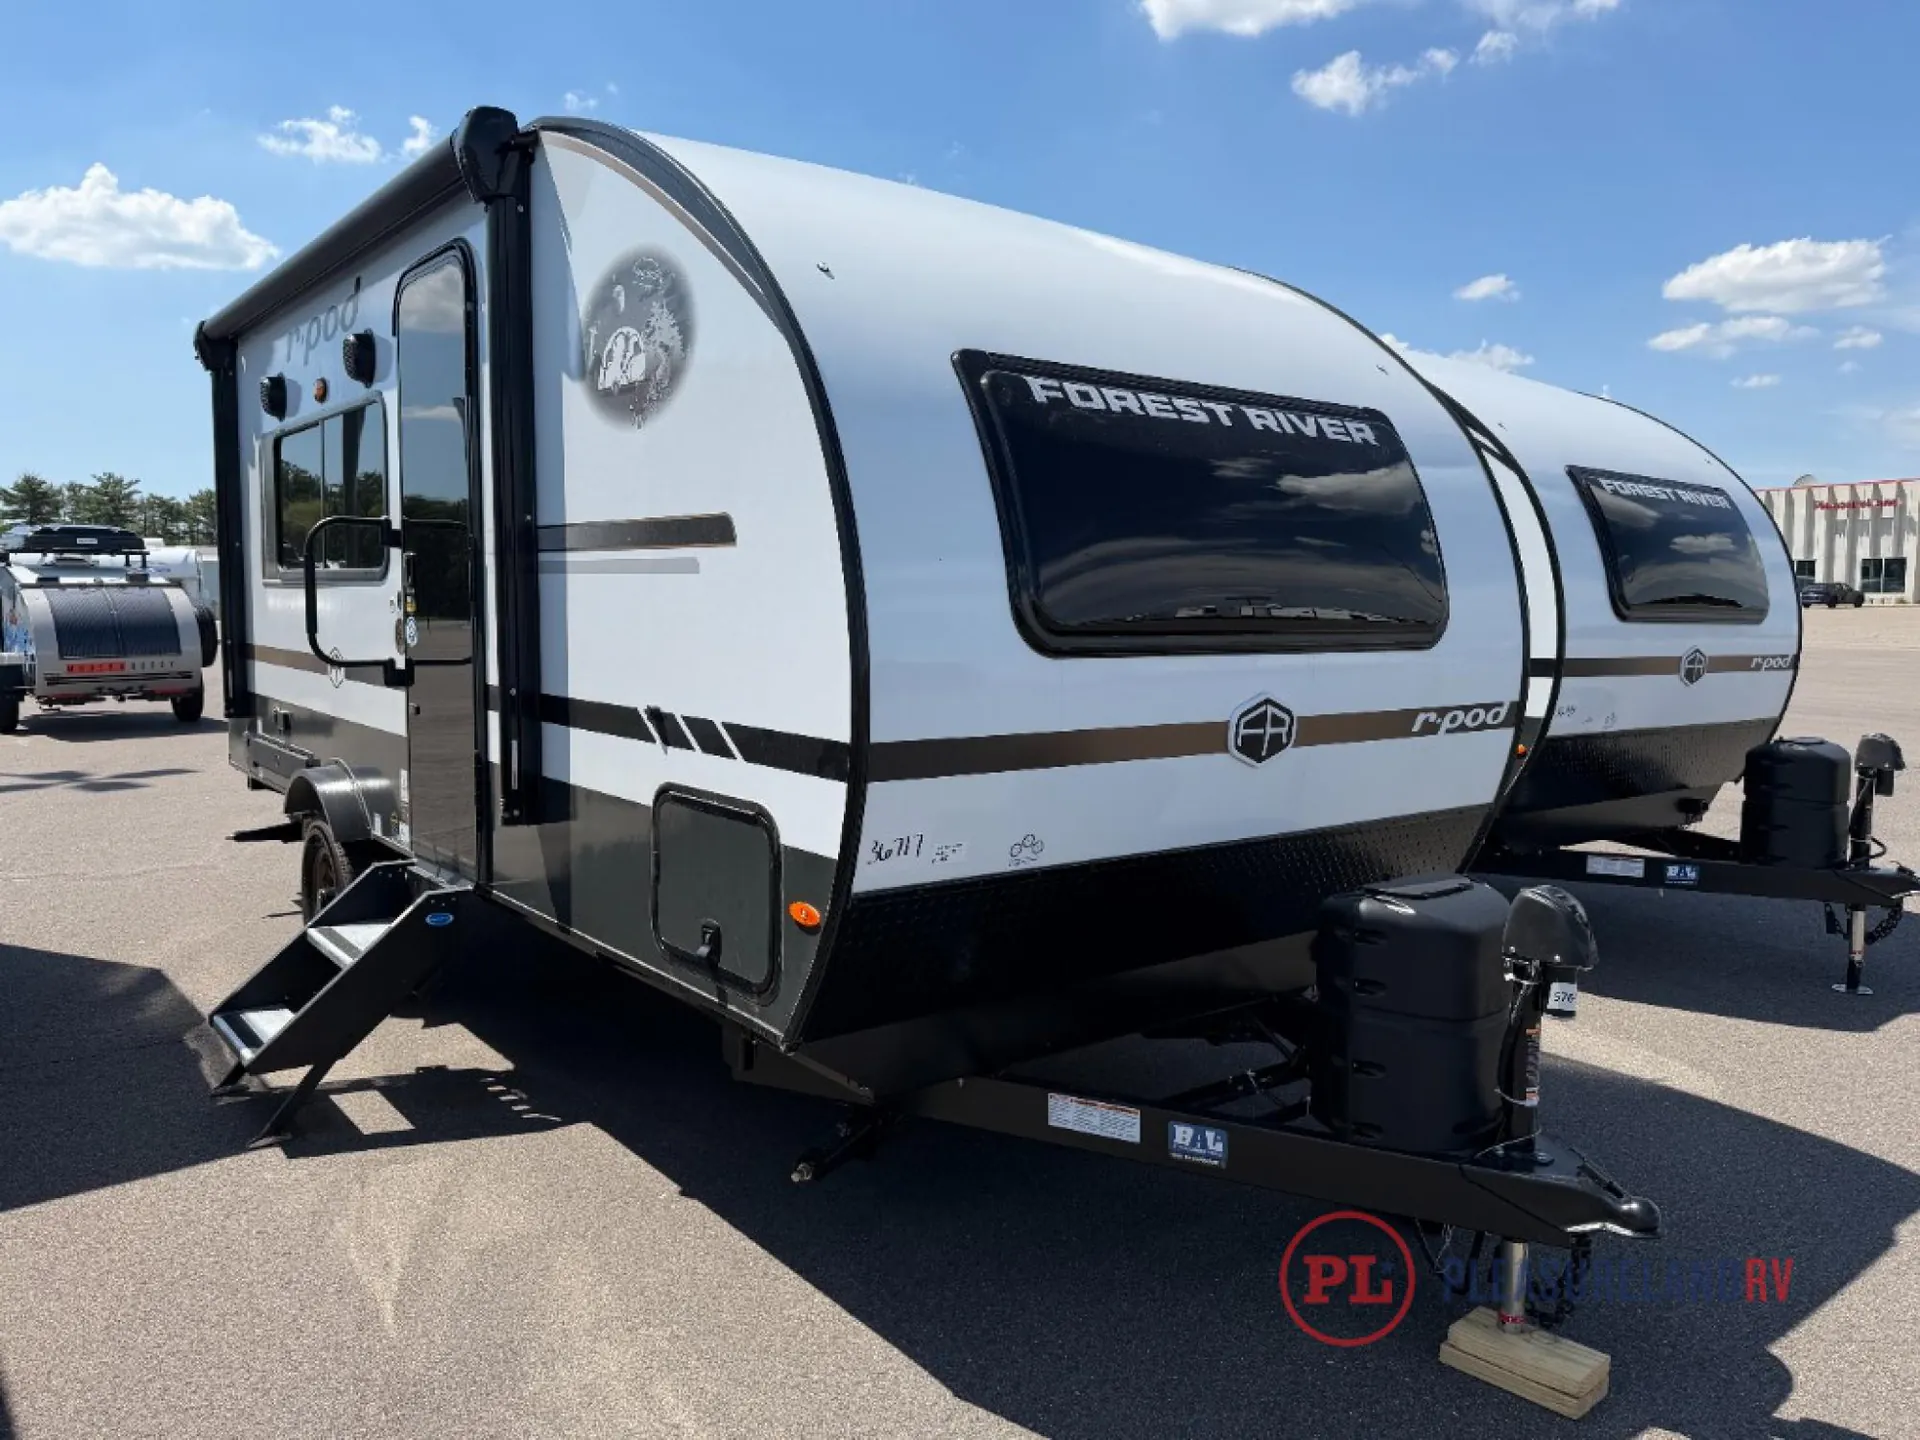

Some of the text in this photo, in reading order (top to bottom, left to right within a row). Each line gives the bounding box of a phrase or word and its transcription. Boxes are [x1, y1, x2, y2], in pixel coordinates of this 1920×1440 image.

[1024, 376, 1379, 446] FOREST RIVER
[1598, 478, 1731, 509] FOREST RIVER
